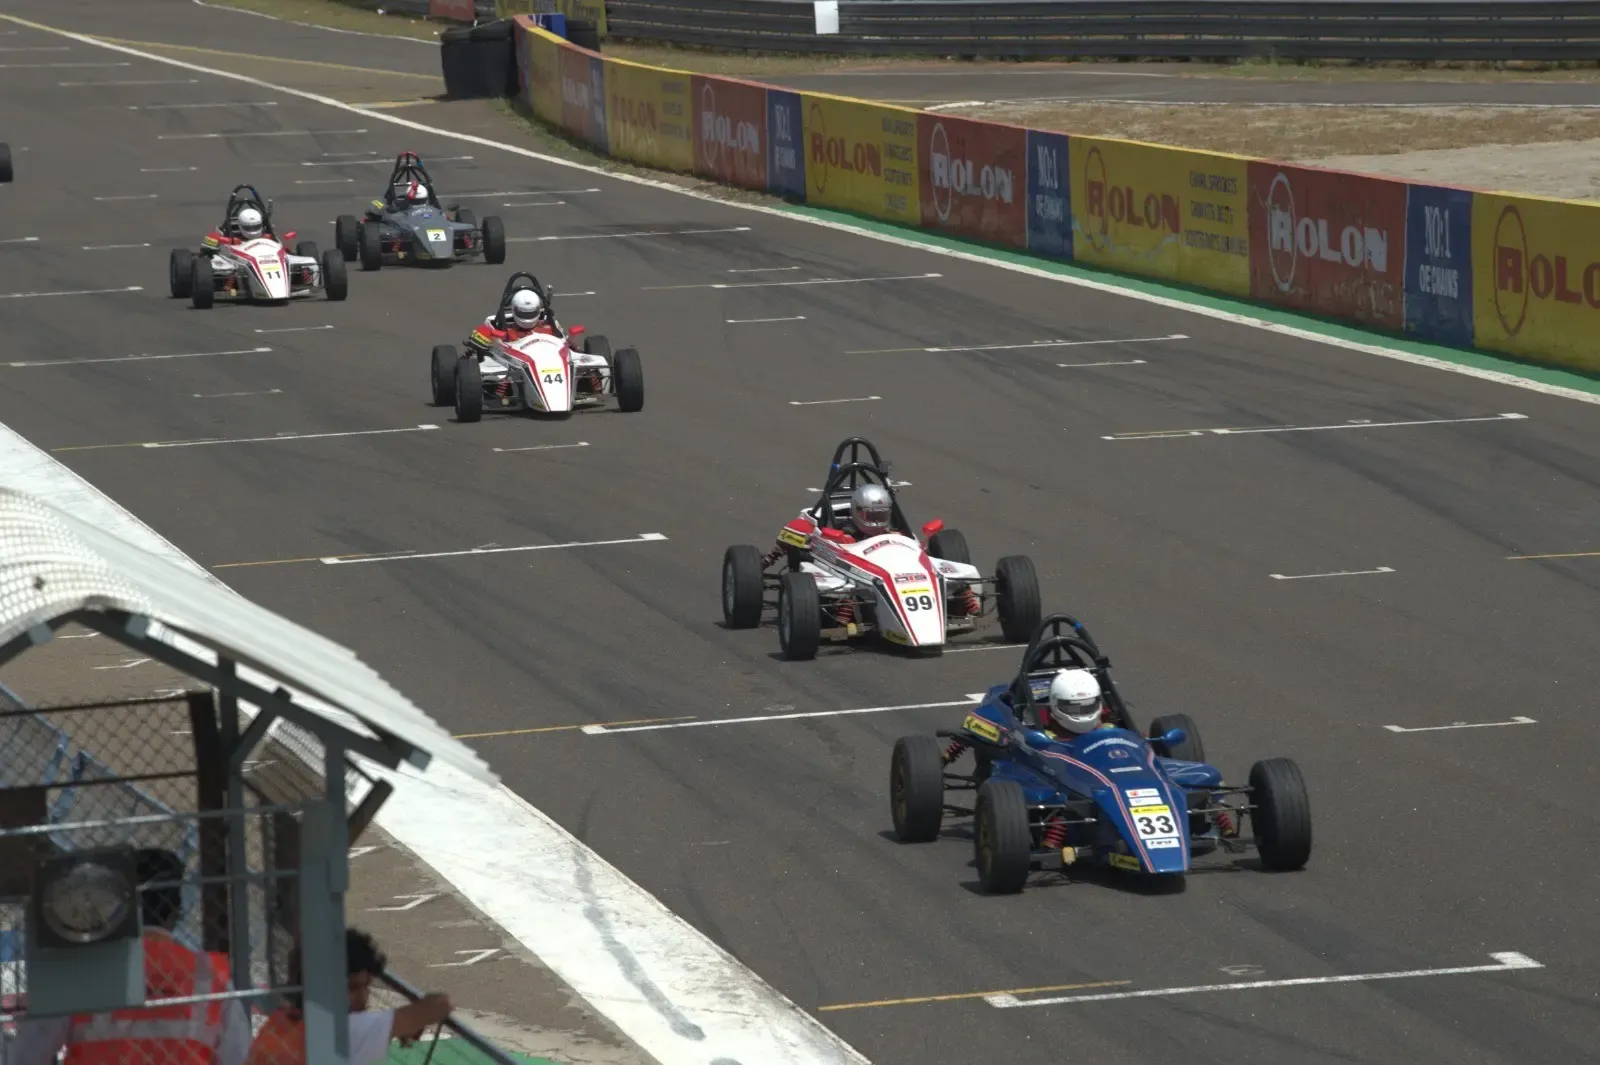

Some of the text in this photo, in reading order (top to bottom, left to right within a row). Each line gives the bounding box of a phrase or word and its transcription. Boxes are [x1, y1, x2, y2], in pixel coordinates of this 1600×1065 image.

[703, 111, 760, 155] ROLON
[812, 132, 882, 177] ROLON
[932, 152, 1013, 204] ROLON
[1088, 180, 1181, 234] ROLON
[433, 233, 441, 241] 2
[1271, 202, 1388, 272] ROLON
[266, 271, 281, 279] 11
[543, 373, 563, 384] 44
[905, 595, 933, 612] 99
[1138, 815, 1174, 835] 33
